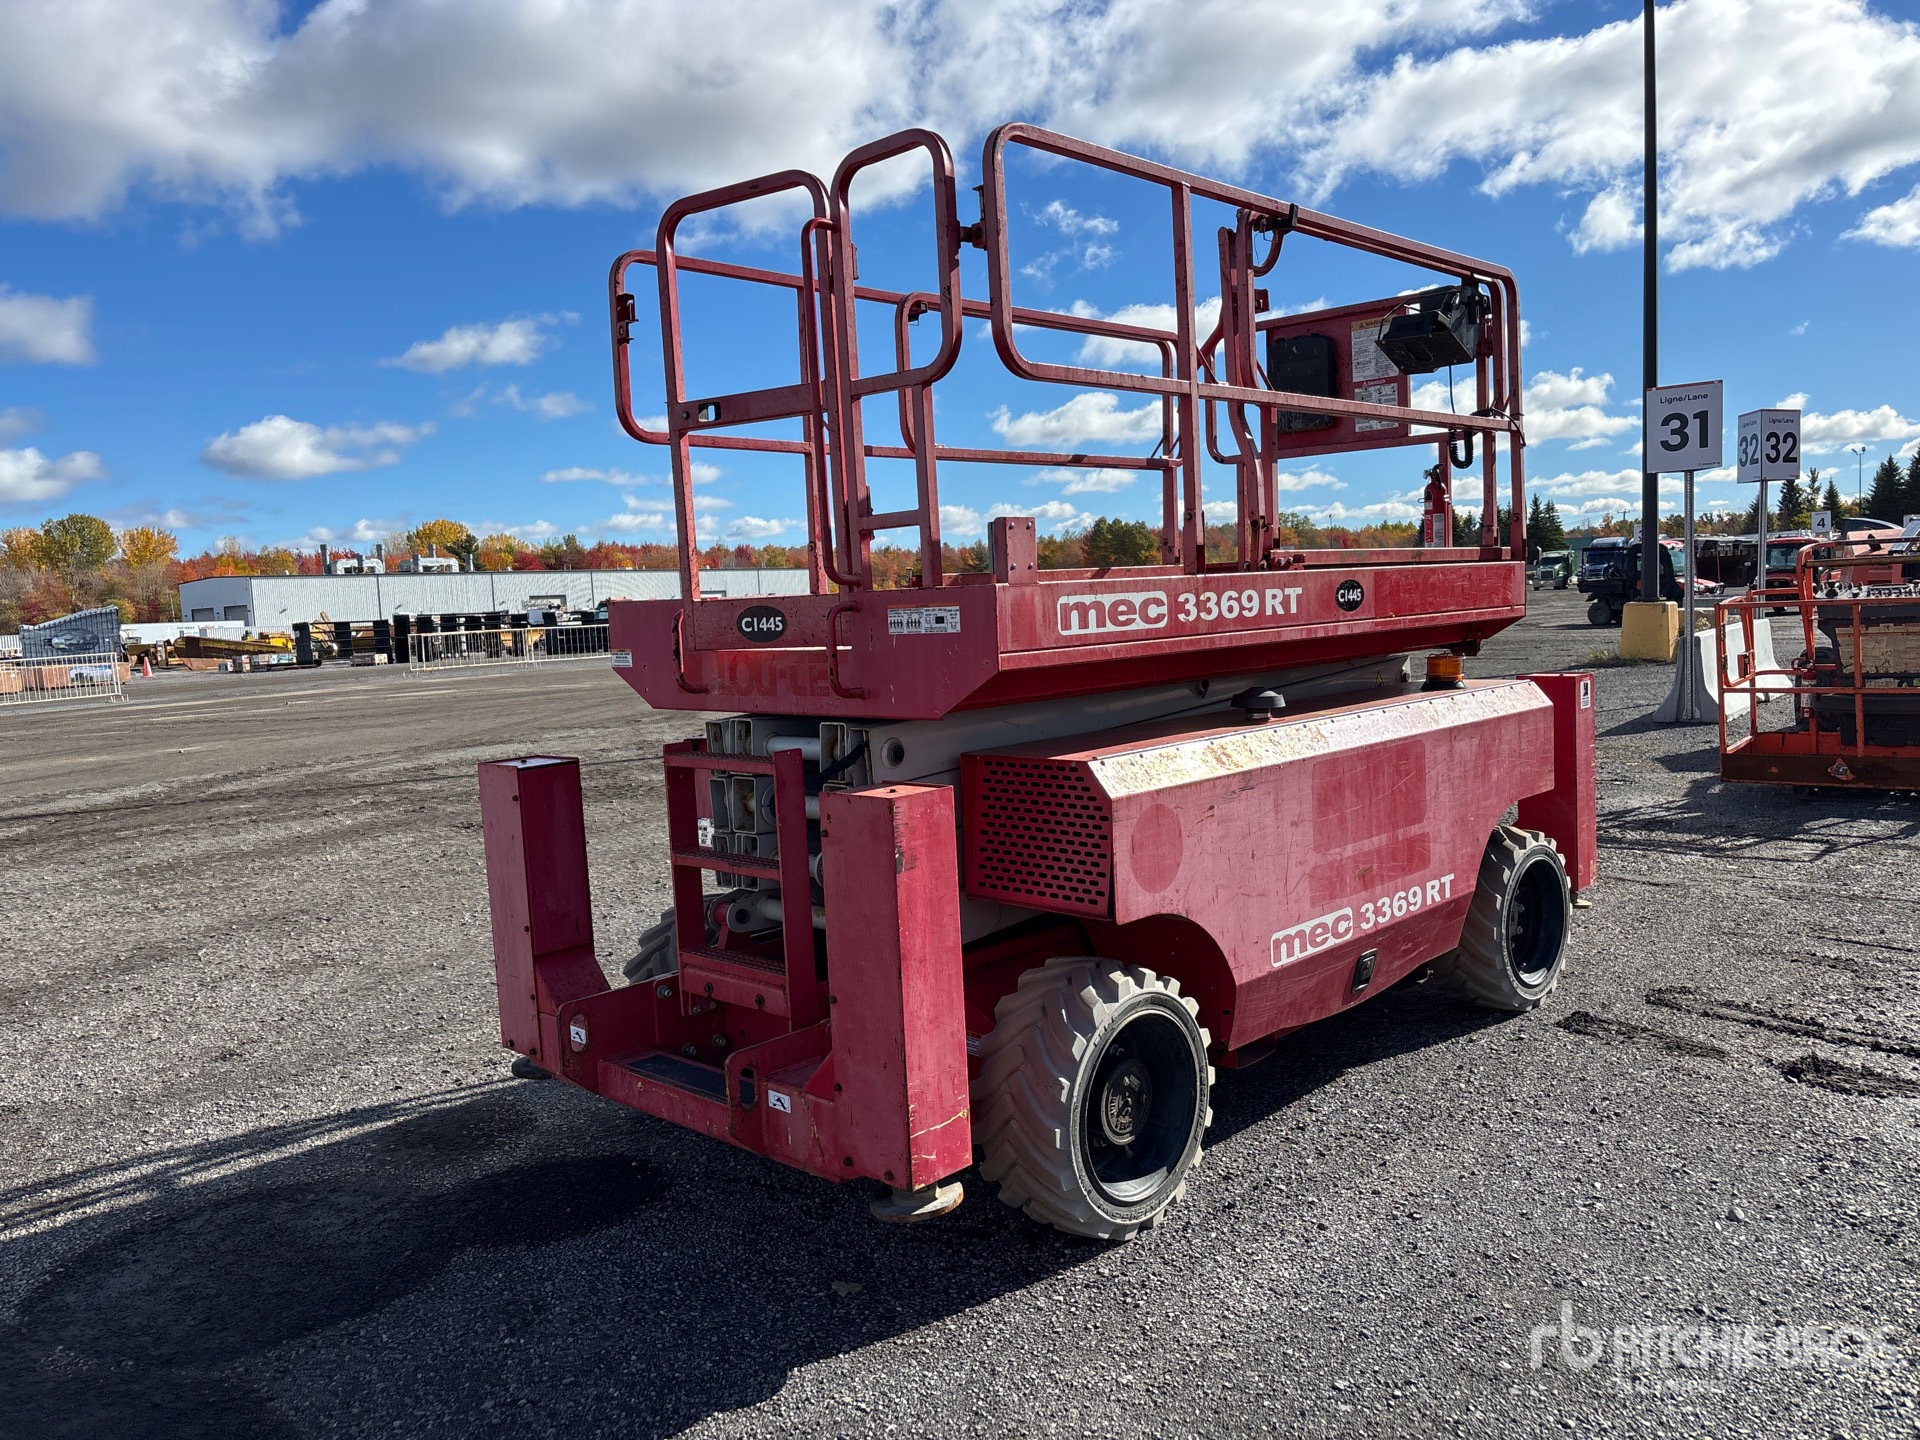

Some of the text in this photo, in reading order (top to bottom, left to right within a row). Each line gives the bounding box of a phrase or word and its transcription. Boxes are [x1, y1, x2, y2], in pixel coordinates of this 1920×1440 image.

[1660, 393, 1709, 405] Ligne/Lane
[1660, 409, 1709, 452] 31
[1768, 417, 1795, 425] Ligne/Lane
[1738, 433, 1760, 468] 32
[1765, 431, 1798, 464] 32
[1816, 517, 1826, 529] 4
[1338, 588, 1362, 602] C1445
[1058, 587, 1303, 633] mec 3369 RT
[741, 616, 783, 632] C1445
[1271, 873, 1455, 965] mec 3369 RT
